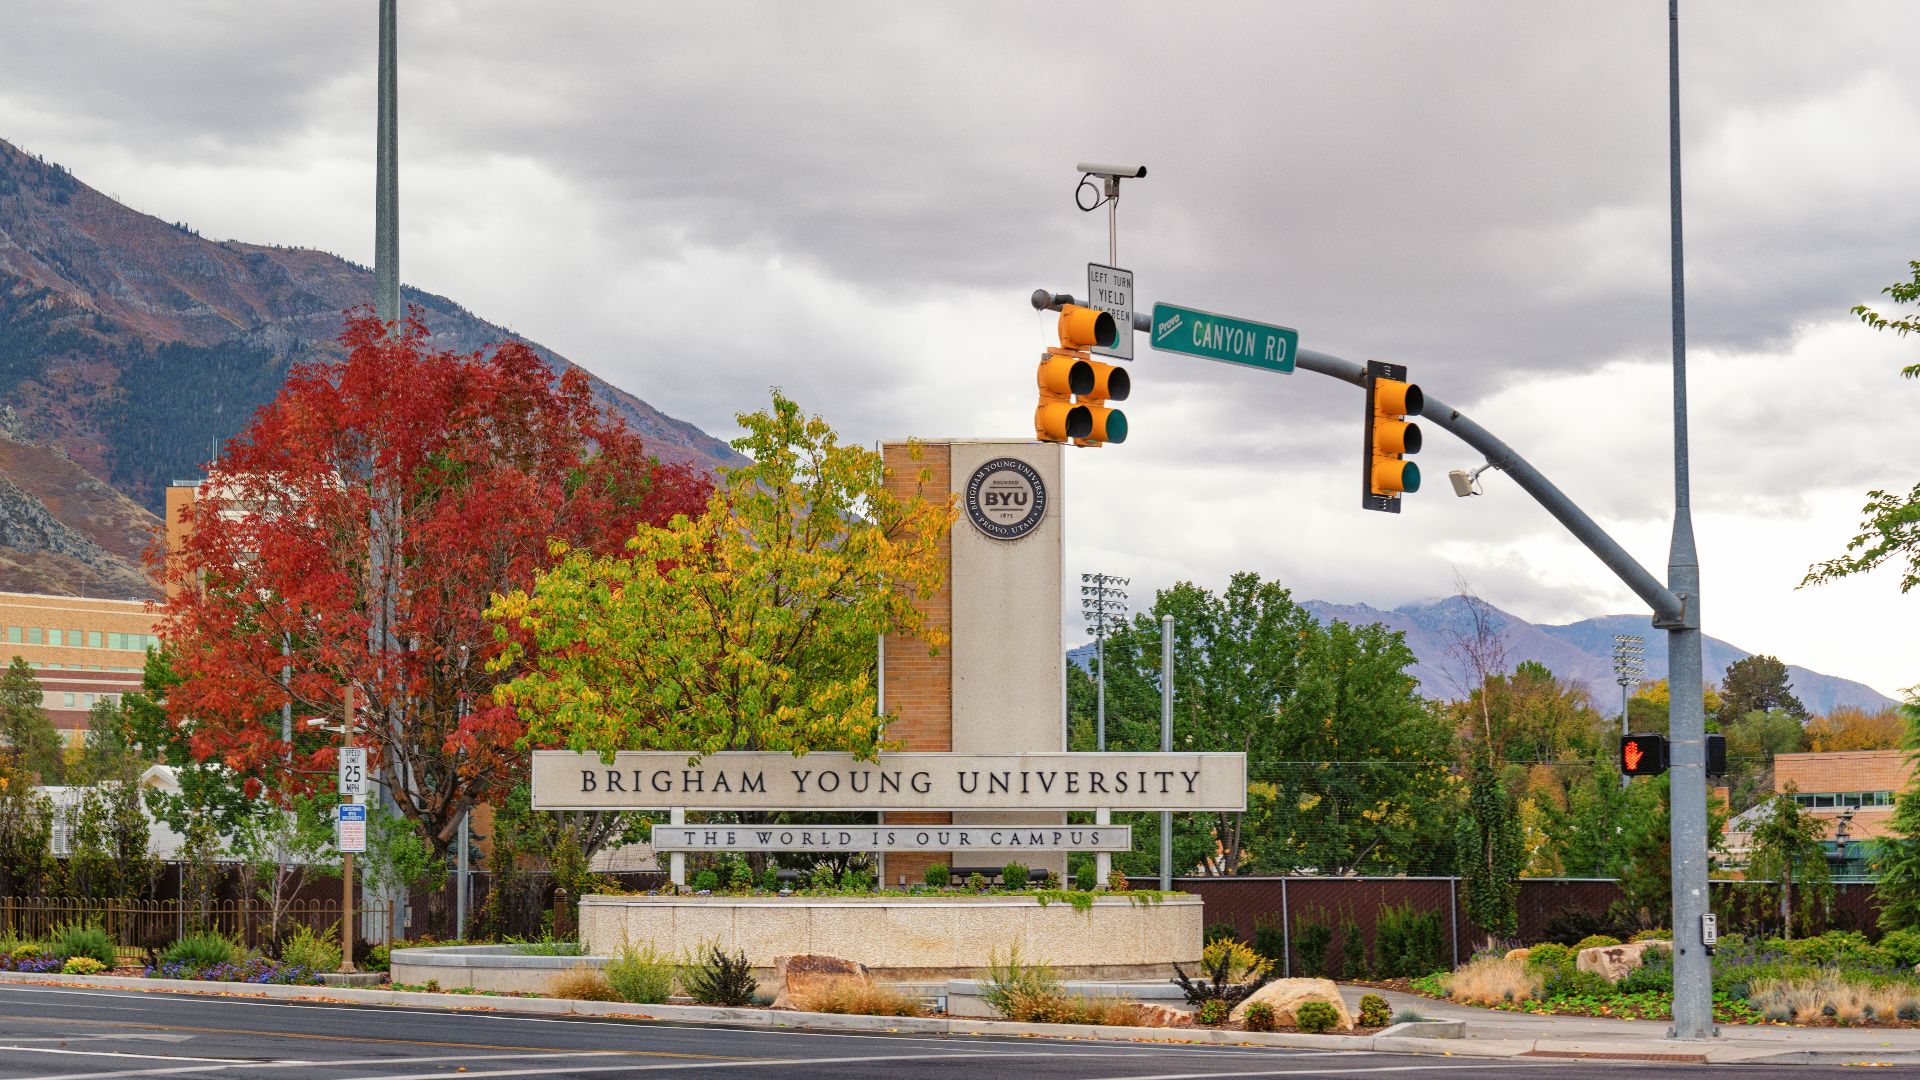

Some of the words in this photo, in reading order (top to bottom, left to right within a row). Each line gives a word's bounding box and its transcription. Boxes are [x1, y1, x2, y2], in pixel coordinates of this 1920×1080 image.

[1091, 270, 1107, 284] LEFT
[1113, 275, 1131, 289] TURN
[1098, 288, 1125, 306] YIELD
[1158, 314, 1180, 334] Provo
[1192, 320, 1256, 357] CANYON
[1265, 335, 1287, 362] RD
[969, 471, 985, 511] BRIGHAM
[984, 461, 1016, 472] YOUNG
[1018, 464, 1044, 511] UNIVERSITY
[984, 492, 1028, 506] BYU
[1011, 517, 1035, 534] UTAH
[345, 749, 361, 757] SPEED
[346, 756, 359, 764] LIMIT
[345, 765, 361, 783] 25
[581, 770, 767, 793] BRIGHAM
[791, 770, 932, 793] YOUNG
[958, 771, 1201, 794] UNIVERSITY
[346, 783, 360, 792] MPH
[684, 831, 737, 845] THE
[757, 831, 852, 845] WORLD
[872, 831, 896, 845] IS
[916, 831, 972, 846] OUR
[990, 831, 1101, 846] CAMPUS
